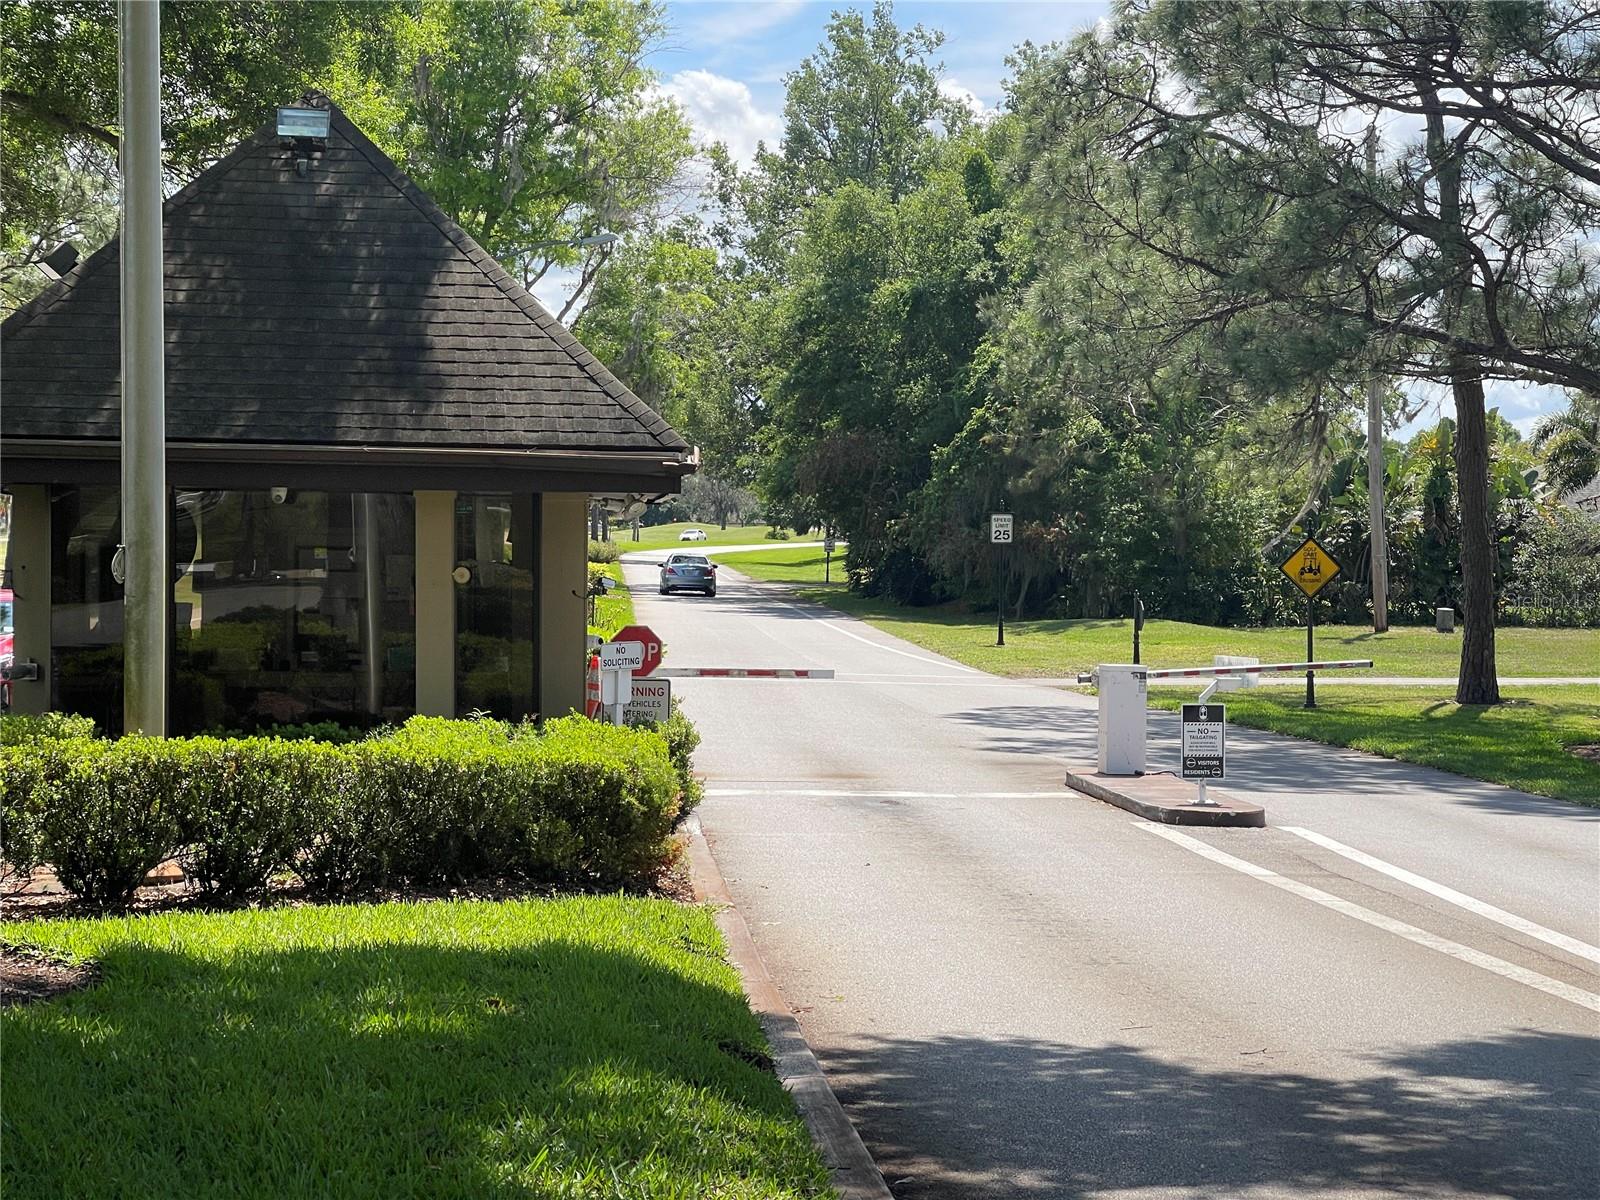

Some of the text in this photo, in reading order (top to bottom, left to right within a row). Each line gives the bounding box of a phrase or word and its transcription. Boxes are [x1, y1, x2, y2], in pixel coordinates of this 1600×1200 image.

[994, 529, 1010, 540] 25
[616, 646, 626, 655] NO
[603, 657, 640, 667] SOLICITING
[631, 687, 665, 697] RNING
[623, 710, 653, 718] NTERING
